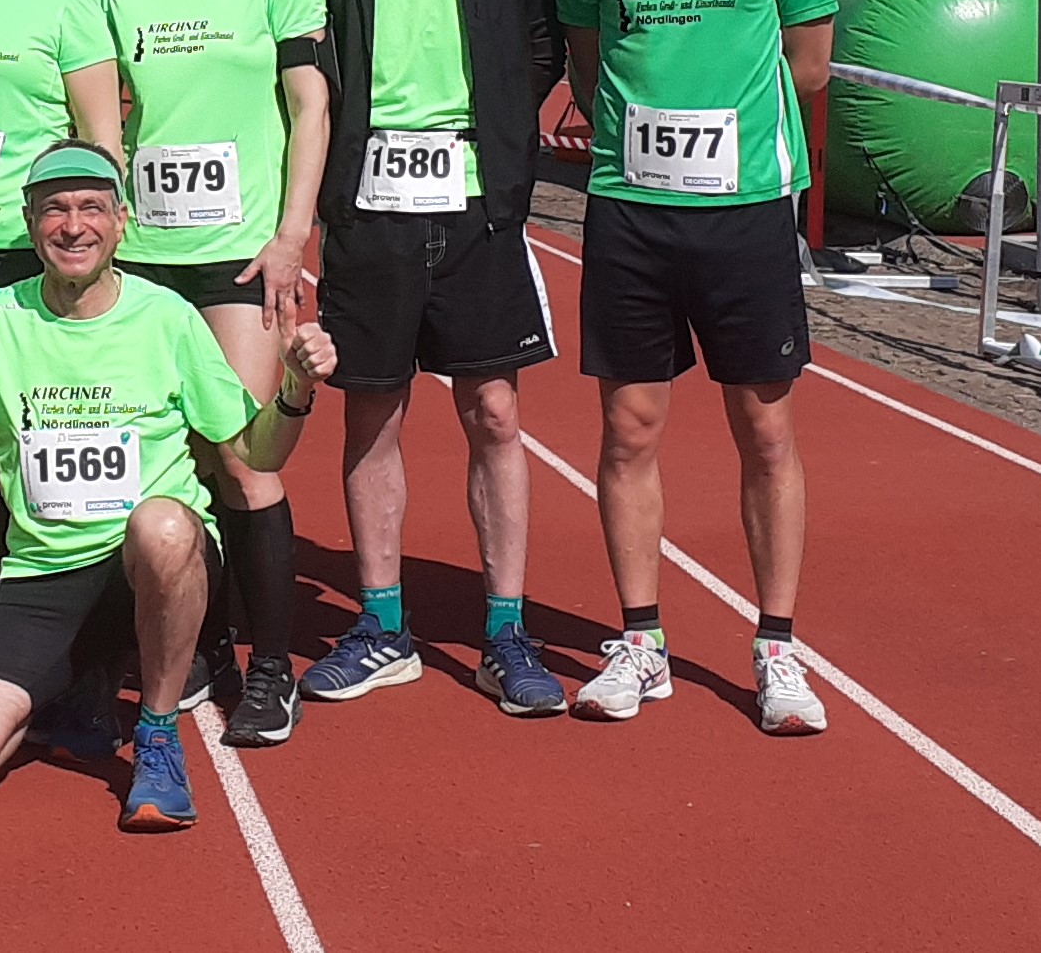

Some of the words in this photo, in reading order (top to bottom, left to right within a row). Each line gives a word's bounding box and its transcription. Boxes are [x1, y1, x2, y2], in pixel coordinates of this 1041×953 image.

[636, 14, 701, 25] Nördlingen
[148, 20, 209, 33] KIRCHNER
[152, 45, 204, 54] Nördlingen
[637, 123, 723, 159] 1577
[372, 148, 451, 178] 1580
[143, 160, 225, 193] 1579
[32, 387, 112, 400] KIRCHNER
[41, 419, 109, 429] Nördlingen
[33, 446, 125, 482] 1569
